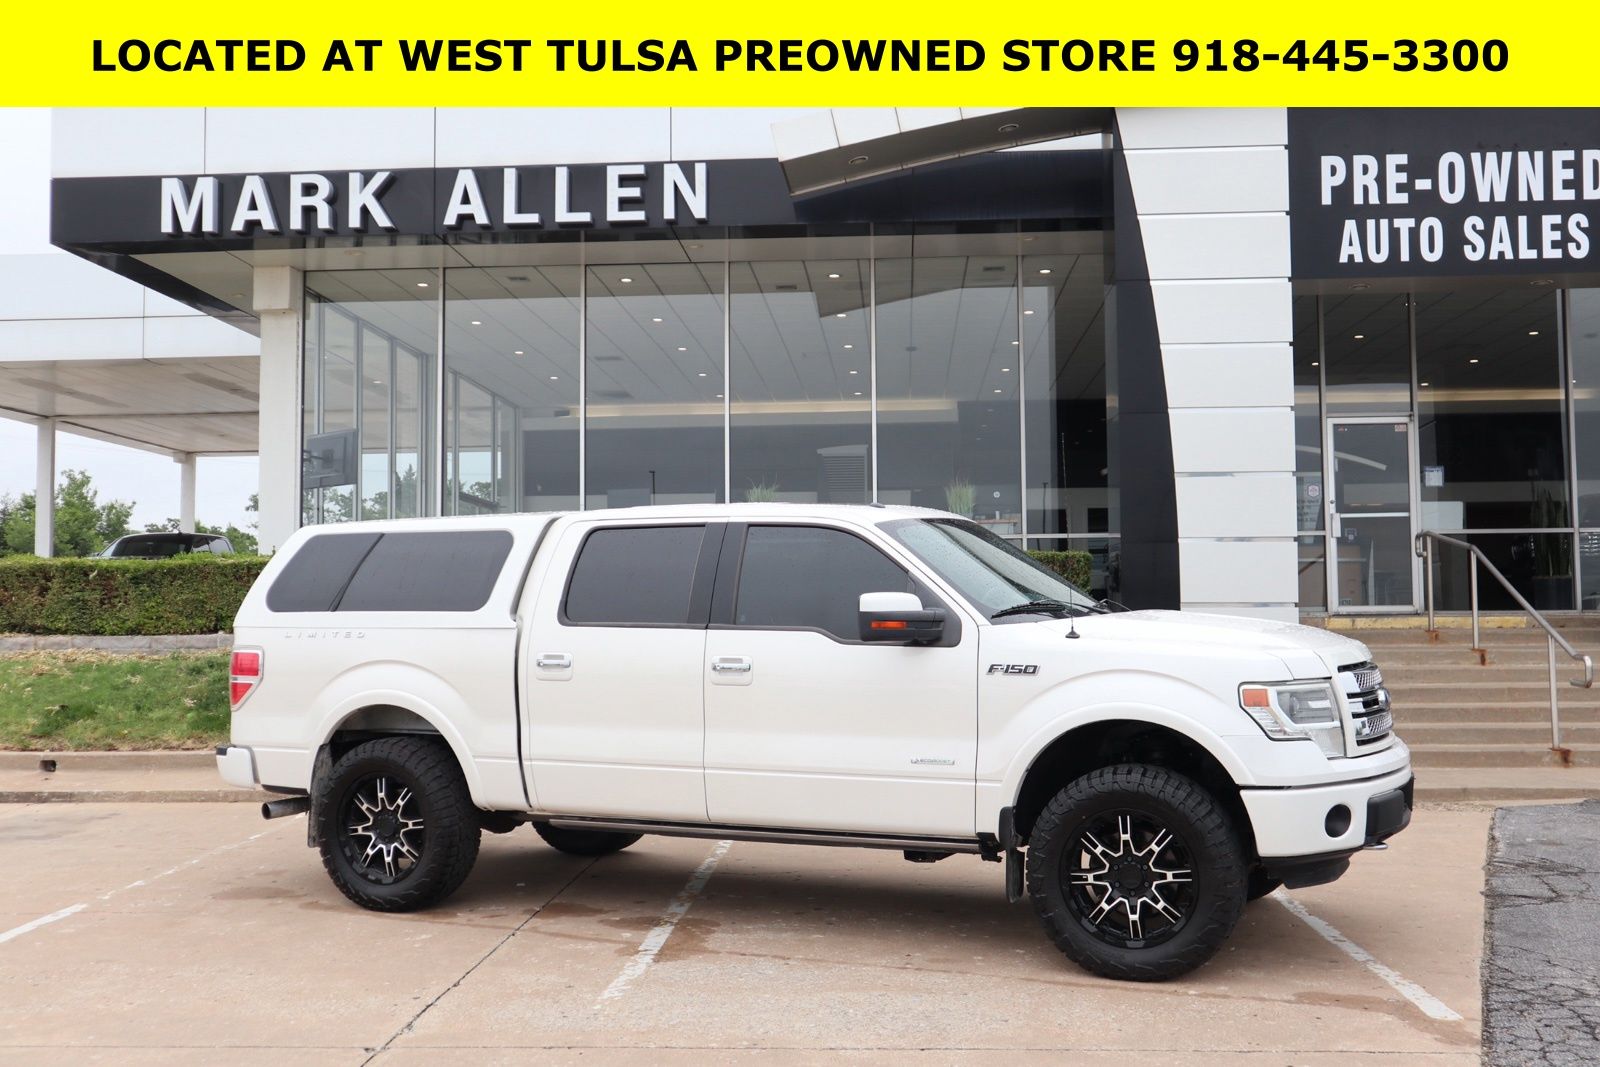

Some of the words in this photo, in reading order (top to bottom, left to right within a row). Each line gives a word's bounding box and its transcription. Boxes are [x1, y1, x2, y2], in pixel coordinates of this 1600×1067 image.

[160, 170, 397, 235] MARK
[442, 161, 708, 227] ALLEN
[1320, 149, 1600, 206] PRE-OWNED
[1338, 216, 1444, 264] AUTO
[1463, 212, 1590, 263] SALES
[283, 630, 367, 640] LIMITED
[986, 663, 1040, 676] F-150
